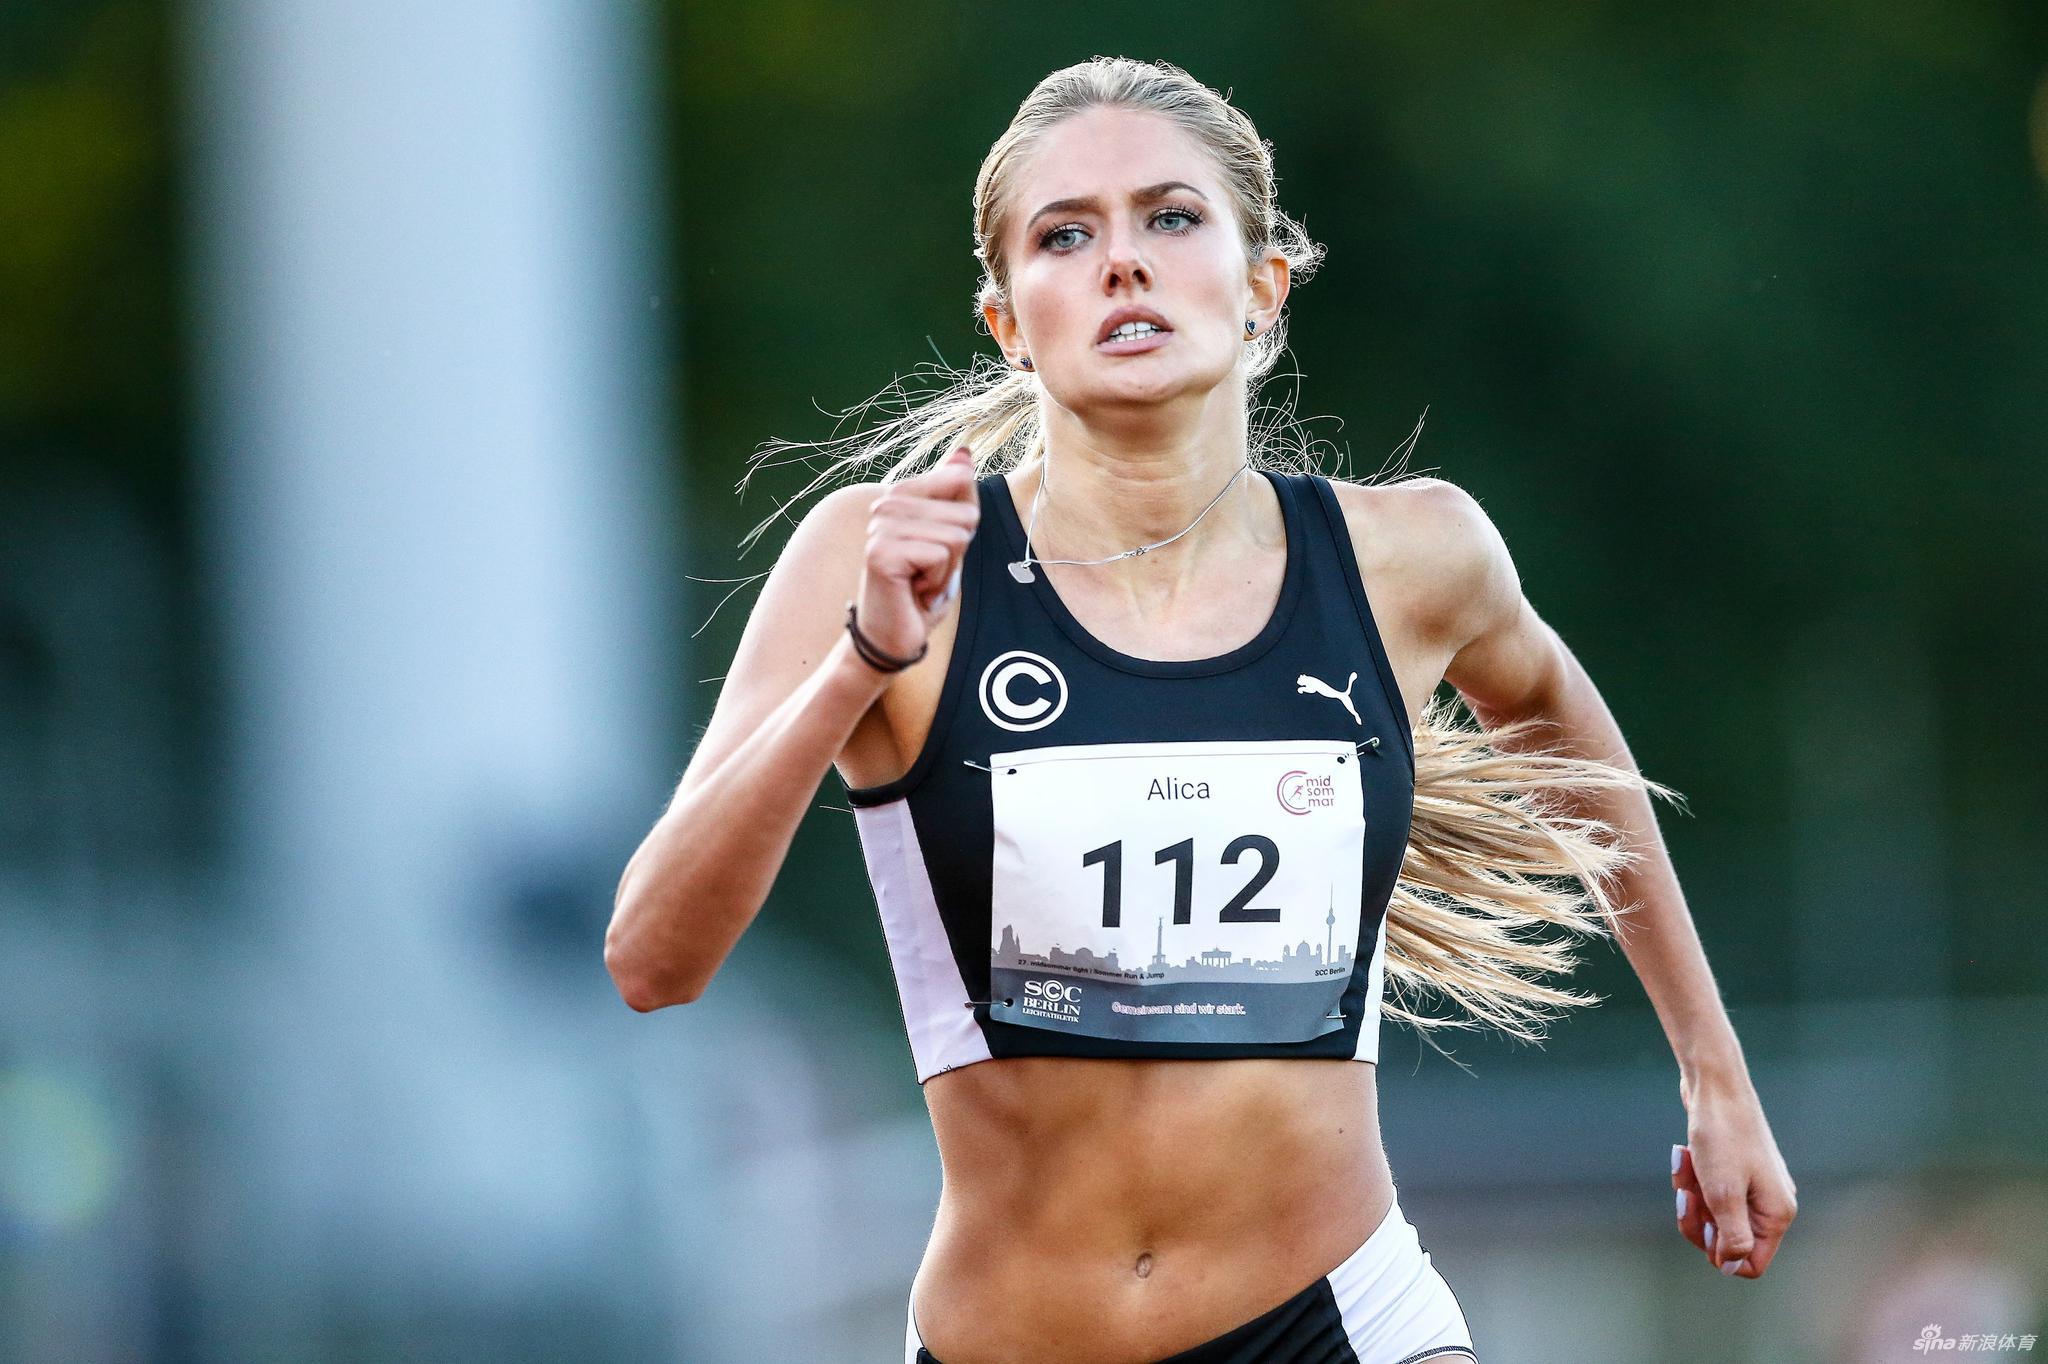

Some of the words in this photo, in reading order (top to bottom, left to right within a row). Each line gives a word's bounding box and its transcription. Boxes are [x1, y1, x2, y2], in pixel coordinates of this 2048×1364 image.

[1305, 775, 1331, 787] mid
[1146, 776, 1211, 801] Alica
[1306, 787, 1335, 797] som
[1308, 798, 1335, 807] mar
[1082, 834, 1282, 929] 112
[1124, 972, 1138, 980] Run
[1139, 972, 1145, 980] &
[1146, 971, 1165, 980] Jump
[1314, 968, 1329, 977] SCC
[1329, 967, 1346, 976] Berlin
[1023, 996, 1082, 1017] BERLIN
[1111, 1001, 1173, 1016] Gemeinsam
[1173, 1002, 1197, 1015] sind
[1197, 1003, 1216, 1015] wir
[1022, 1007, 1080, 1023] LEICHTATHLETIK
